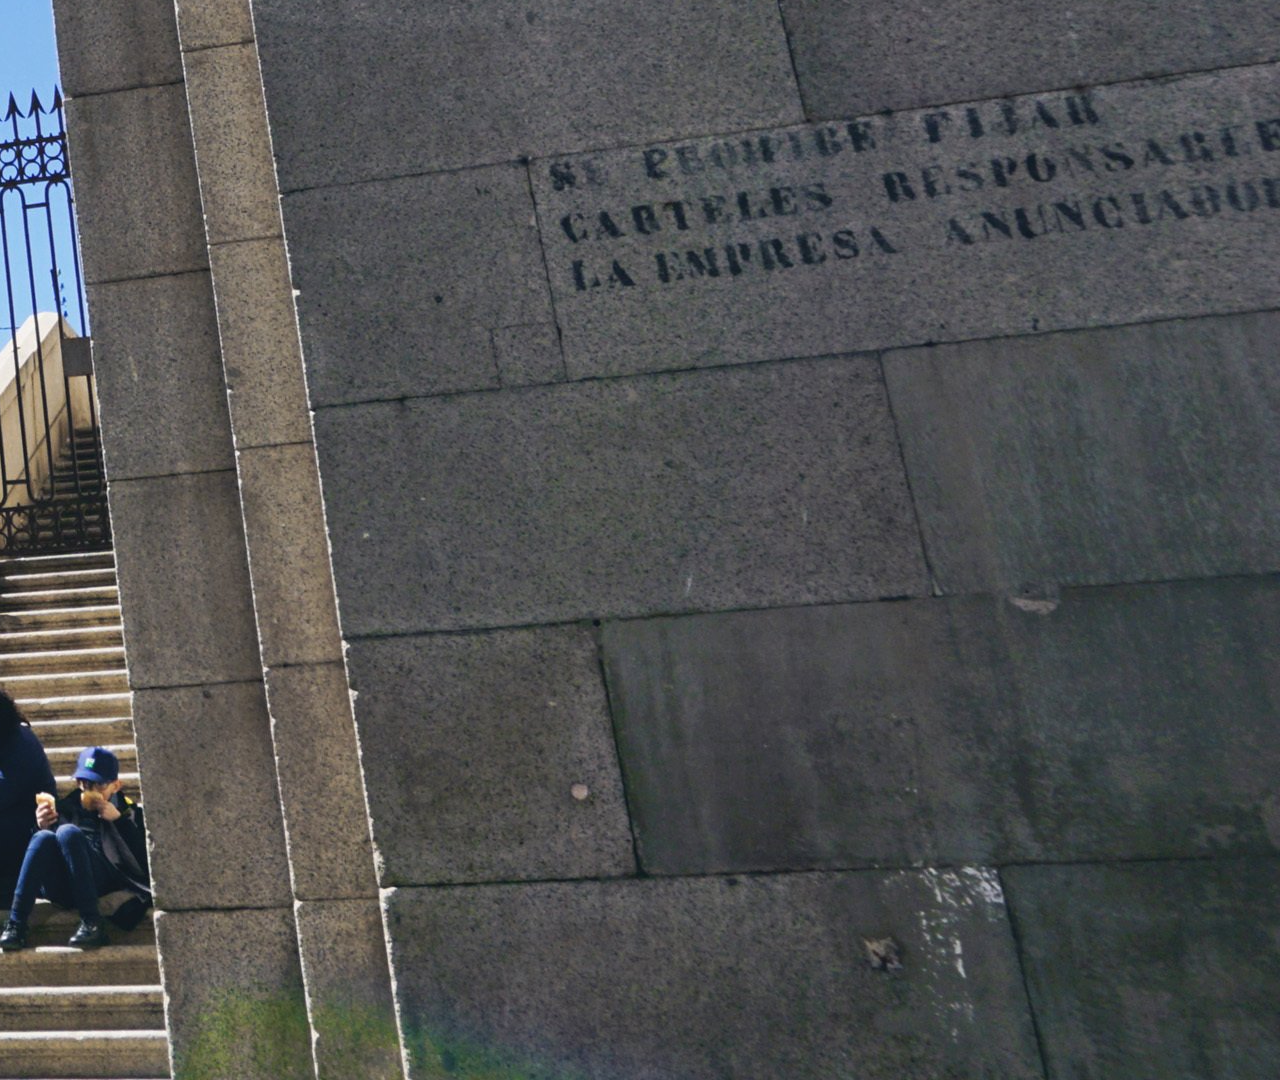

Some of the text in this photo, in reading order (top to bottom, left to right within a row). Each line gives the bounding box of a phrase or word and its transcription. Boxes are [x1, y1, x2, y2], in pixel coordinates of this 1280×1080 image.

[560, 183, 833, 243] CARTELES
[571, 260, 637, 292] LA
[655, 225, 899, 284] EMPRESA
